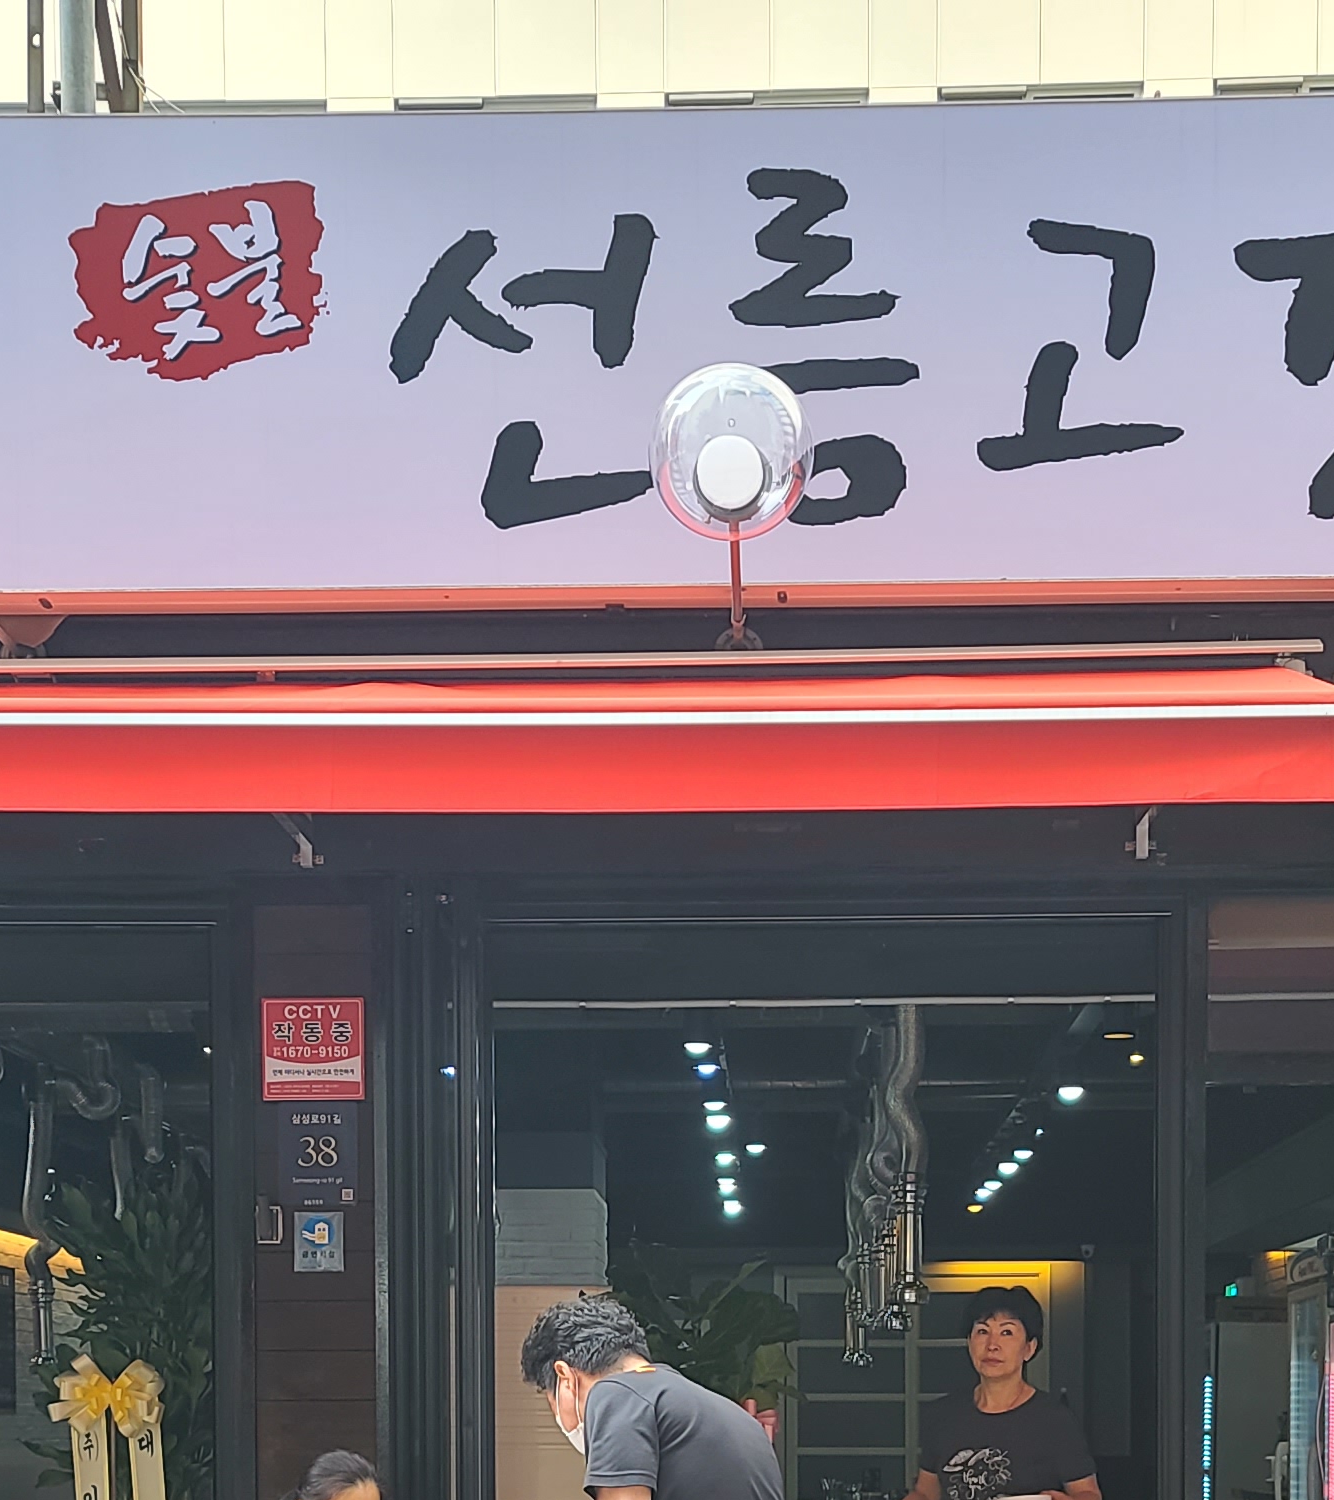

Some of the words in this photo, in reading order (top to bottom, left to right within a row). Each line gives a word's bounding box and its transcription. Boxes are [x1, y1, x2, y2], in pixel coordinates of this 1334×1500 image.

[122, 199, 303, 362] 숯불
[284, 1005, 340, 1019] CCTV
[281, 1046, 349, 1058] 1670-9150
[291, 1113, 342, 1125] 삼성로91길
[297, 1136, 338, 1167] 38
